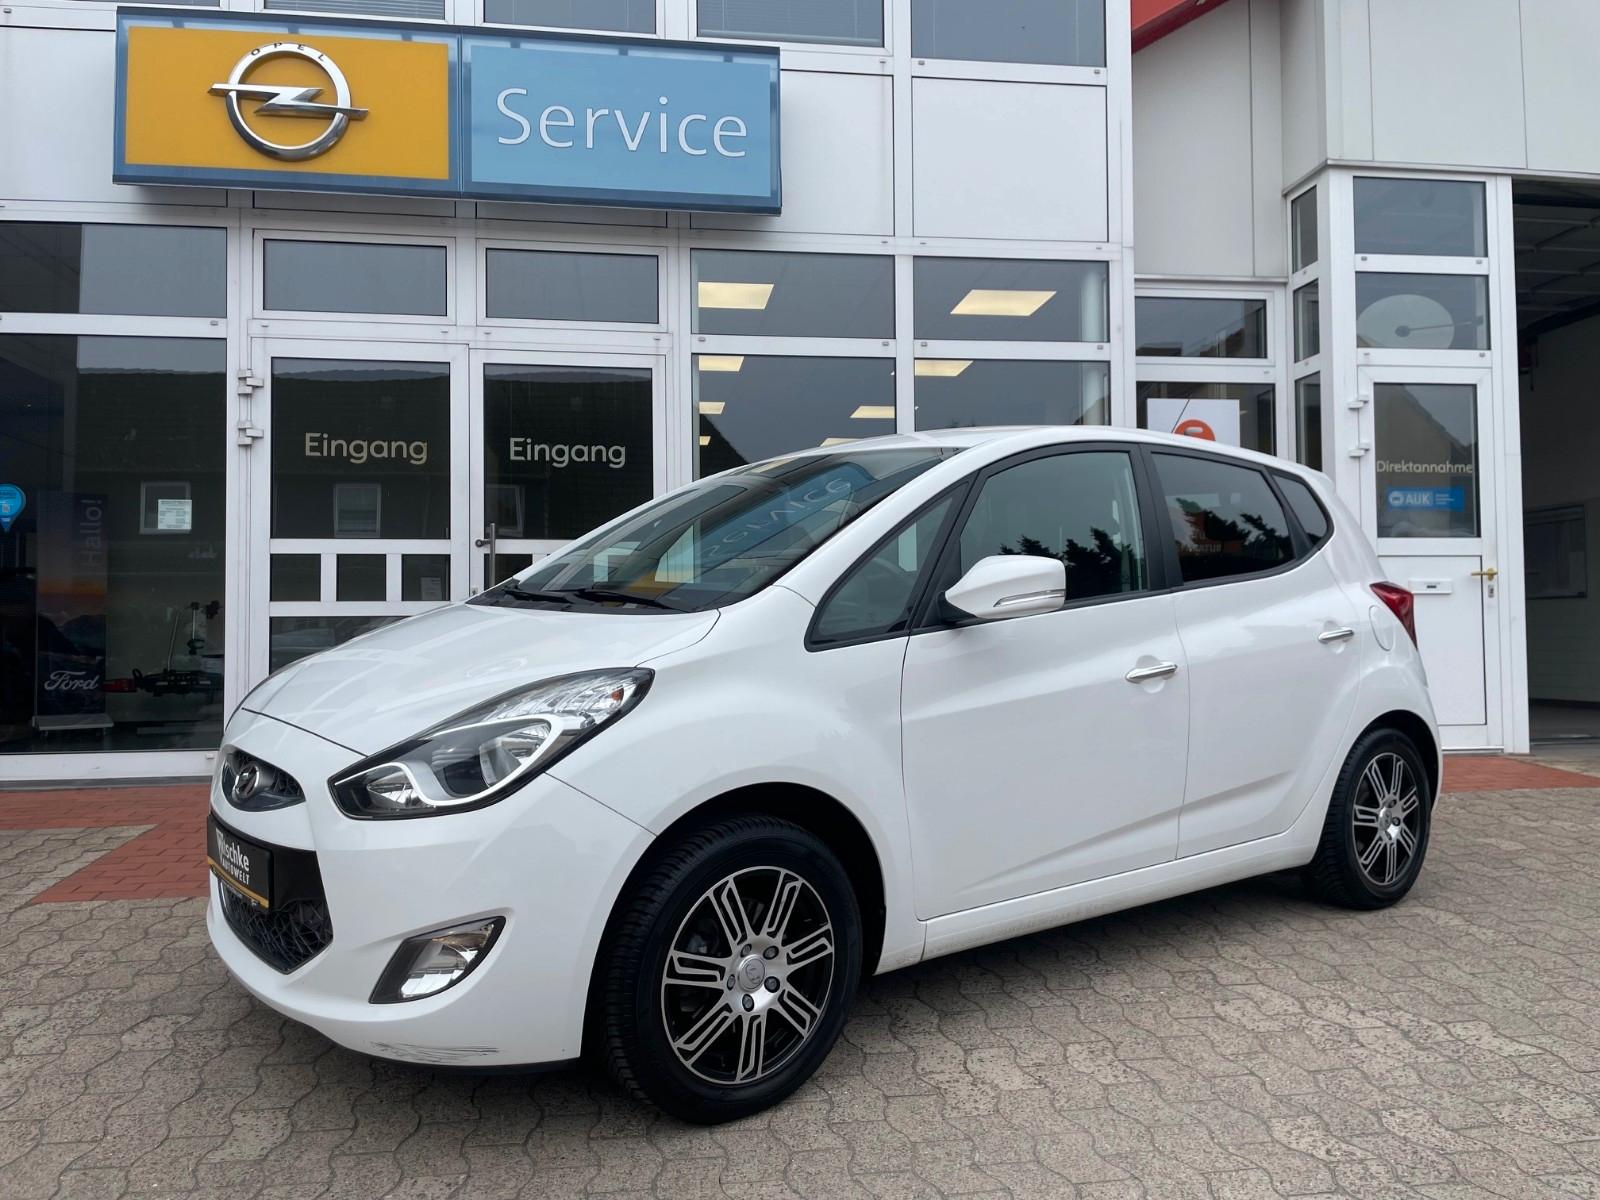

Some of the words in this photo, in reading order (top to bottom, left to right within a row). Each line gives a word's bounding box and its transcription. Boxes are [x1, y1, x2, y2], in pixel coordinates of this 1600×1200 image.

[250, 42, 325, 62] OPEL
[496, 88, 747, 159] Service
[304, 432, 428, 465] Eingang
[509, 437, 627, 469] Eingang
[1376, 459, 1474, 474] Direktannahme
[43, 669, 99, 691] Ford
